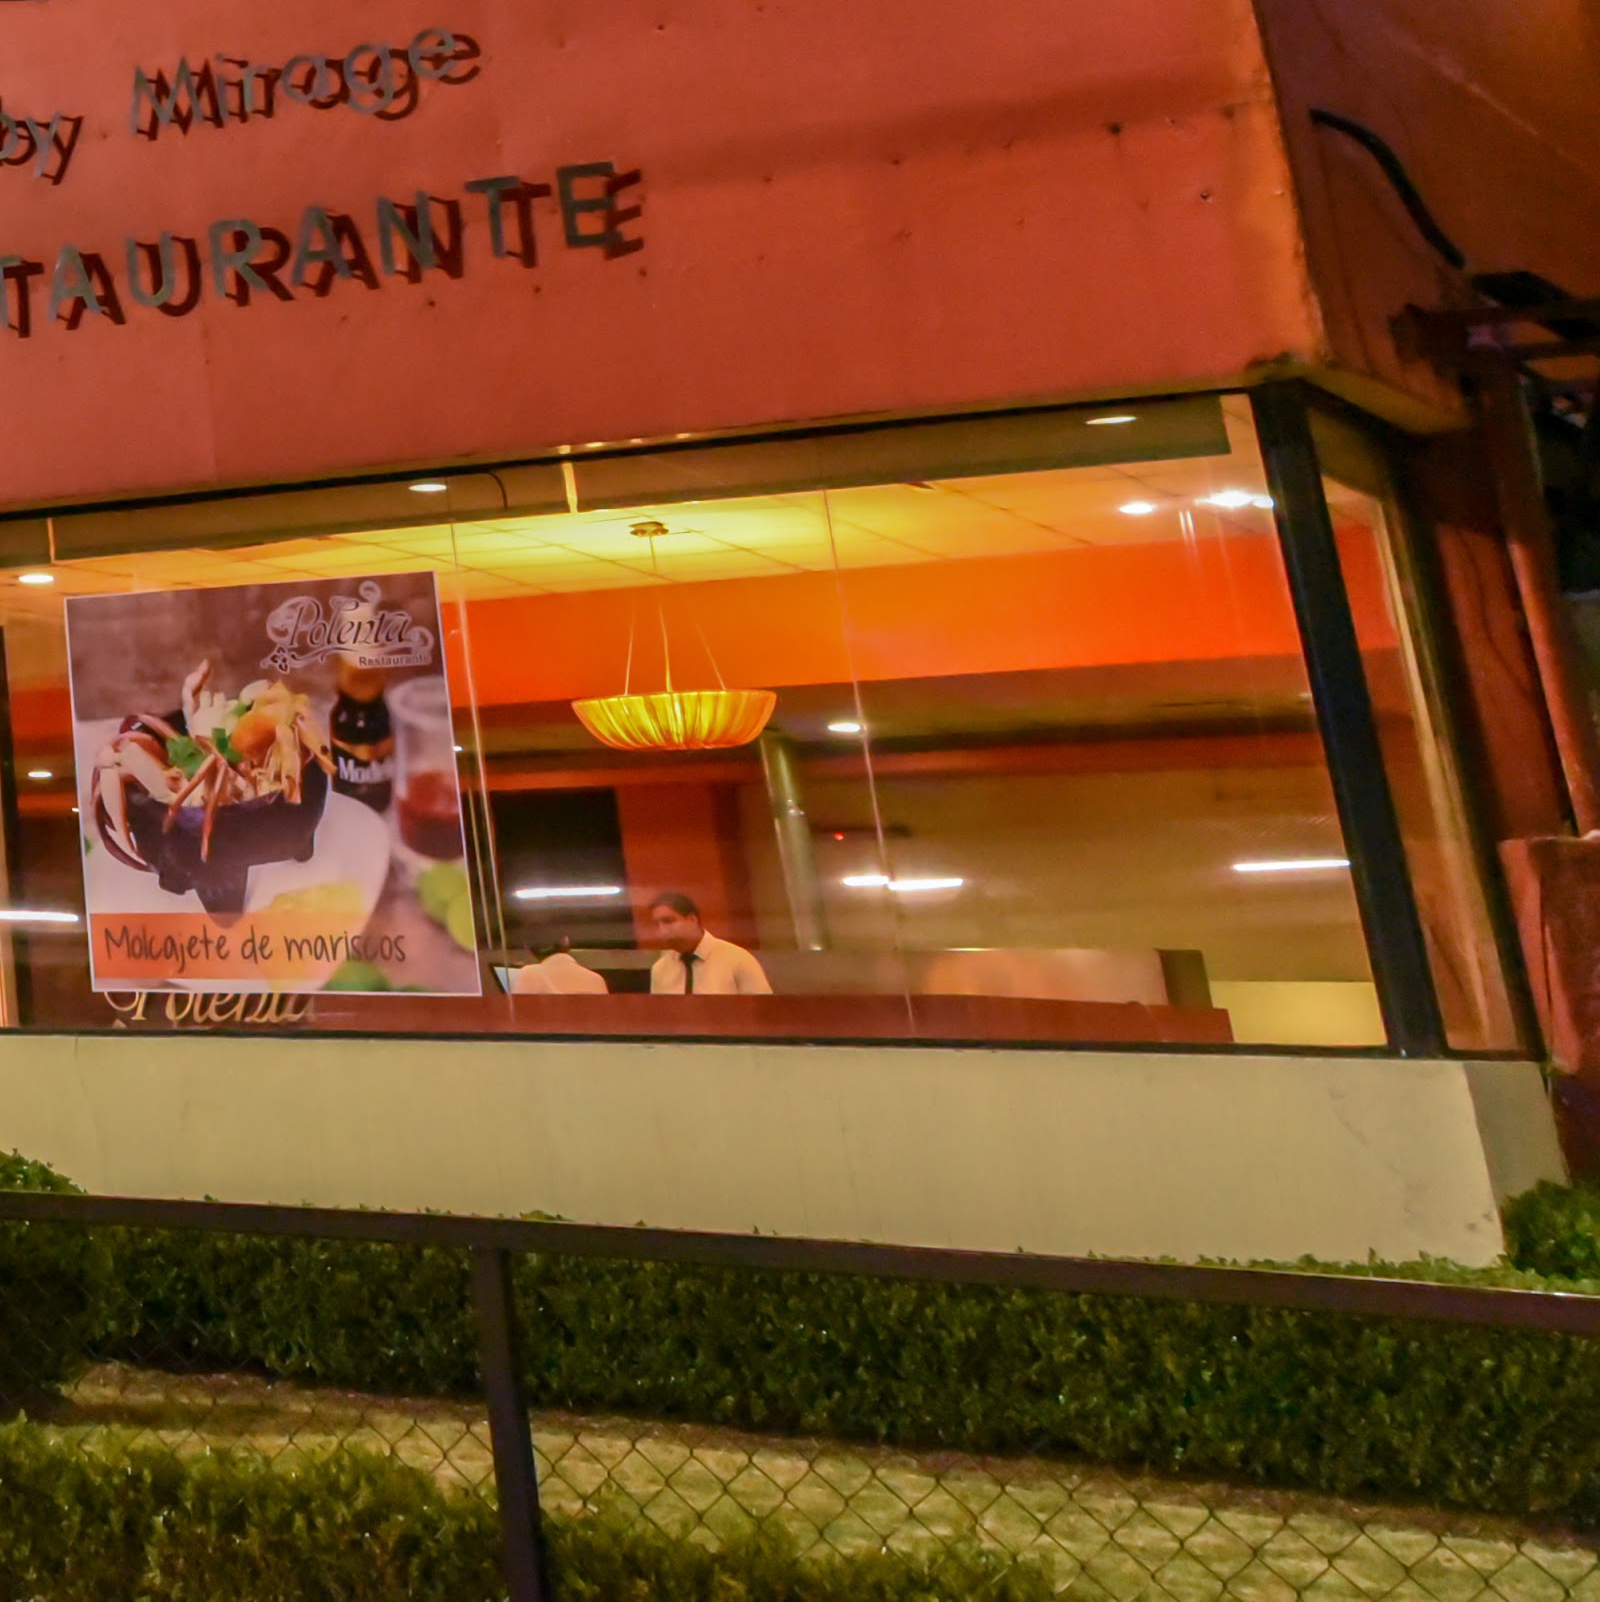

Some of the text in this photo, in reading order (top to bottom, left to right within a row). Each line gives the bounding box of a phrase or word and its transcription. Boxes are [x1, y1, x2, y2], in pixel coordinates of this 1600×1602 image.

[128, 27, 482, 143] Mirage
[267, 581, 434, 653] Polenta
[104, 924, 407, 973] Molcajete de mariscos
